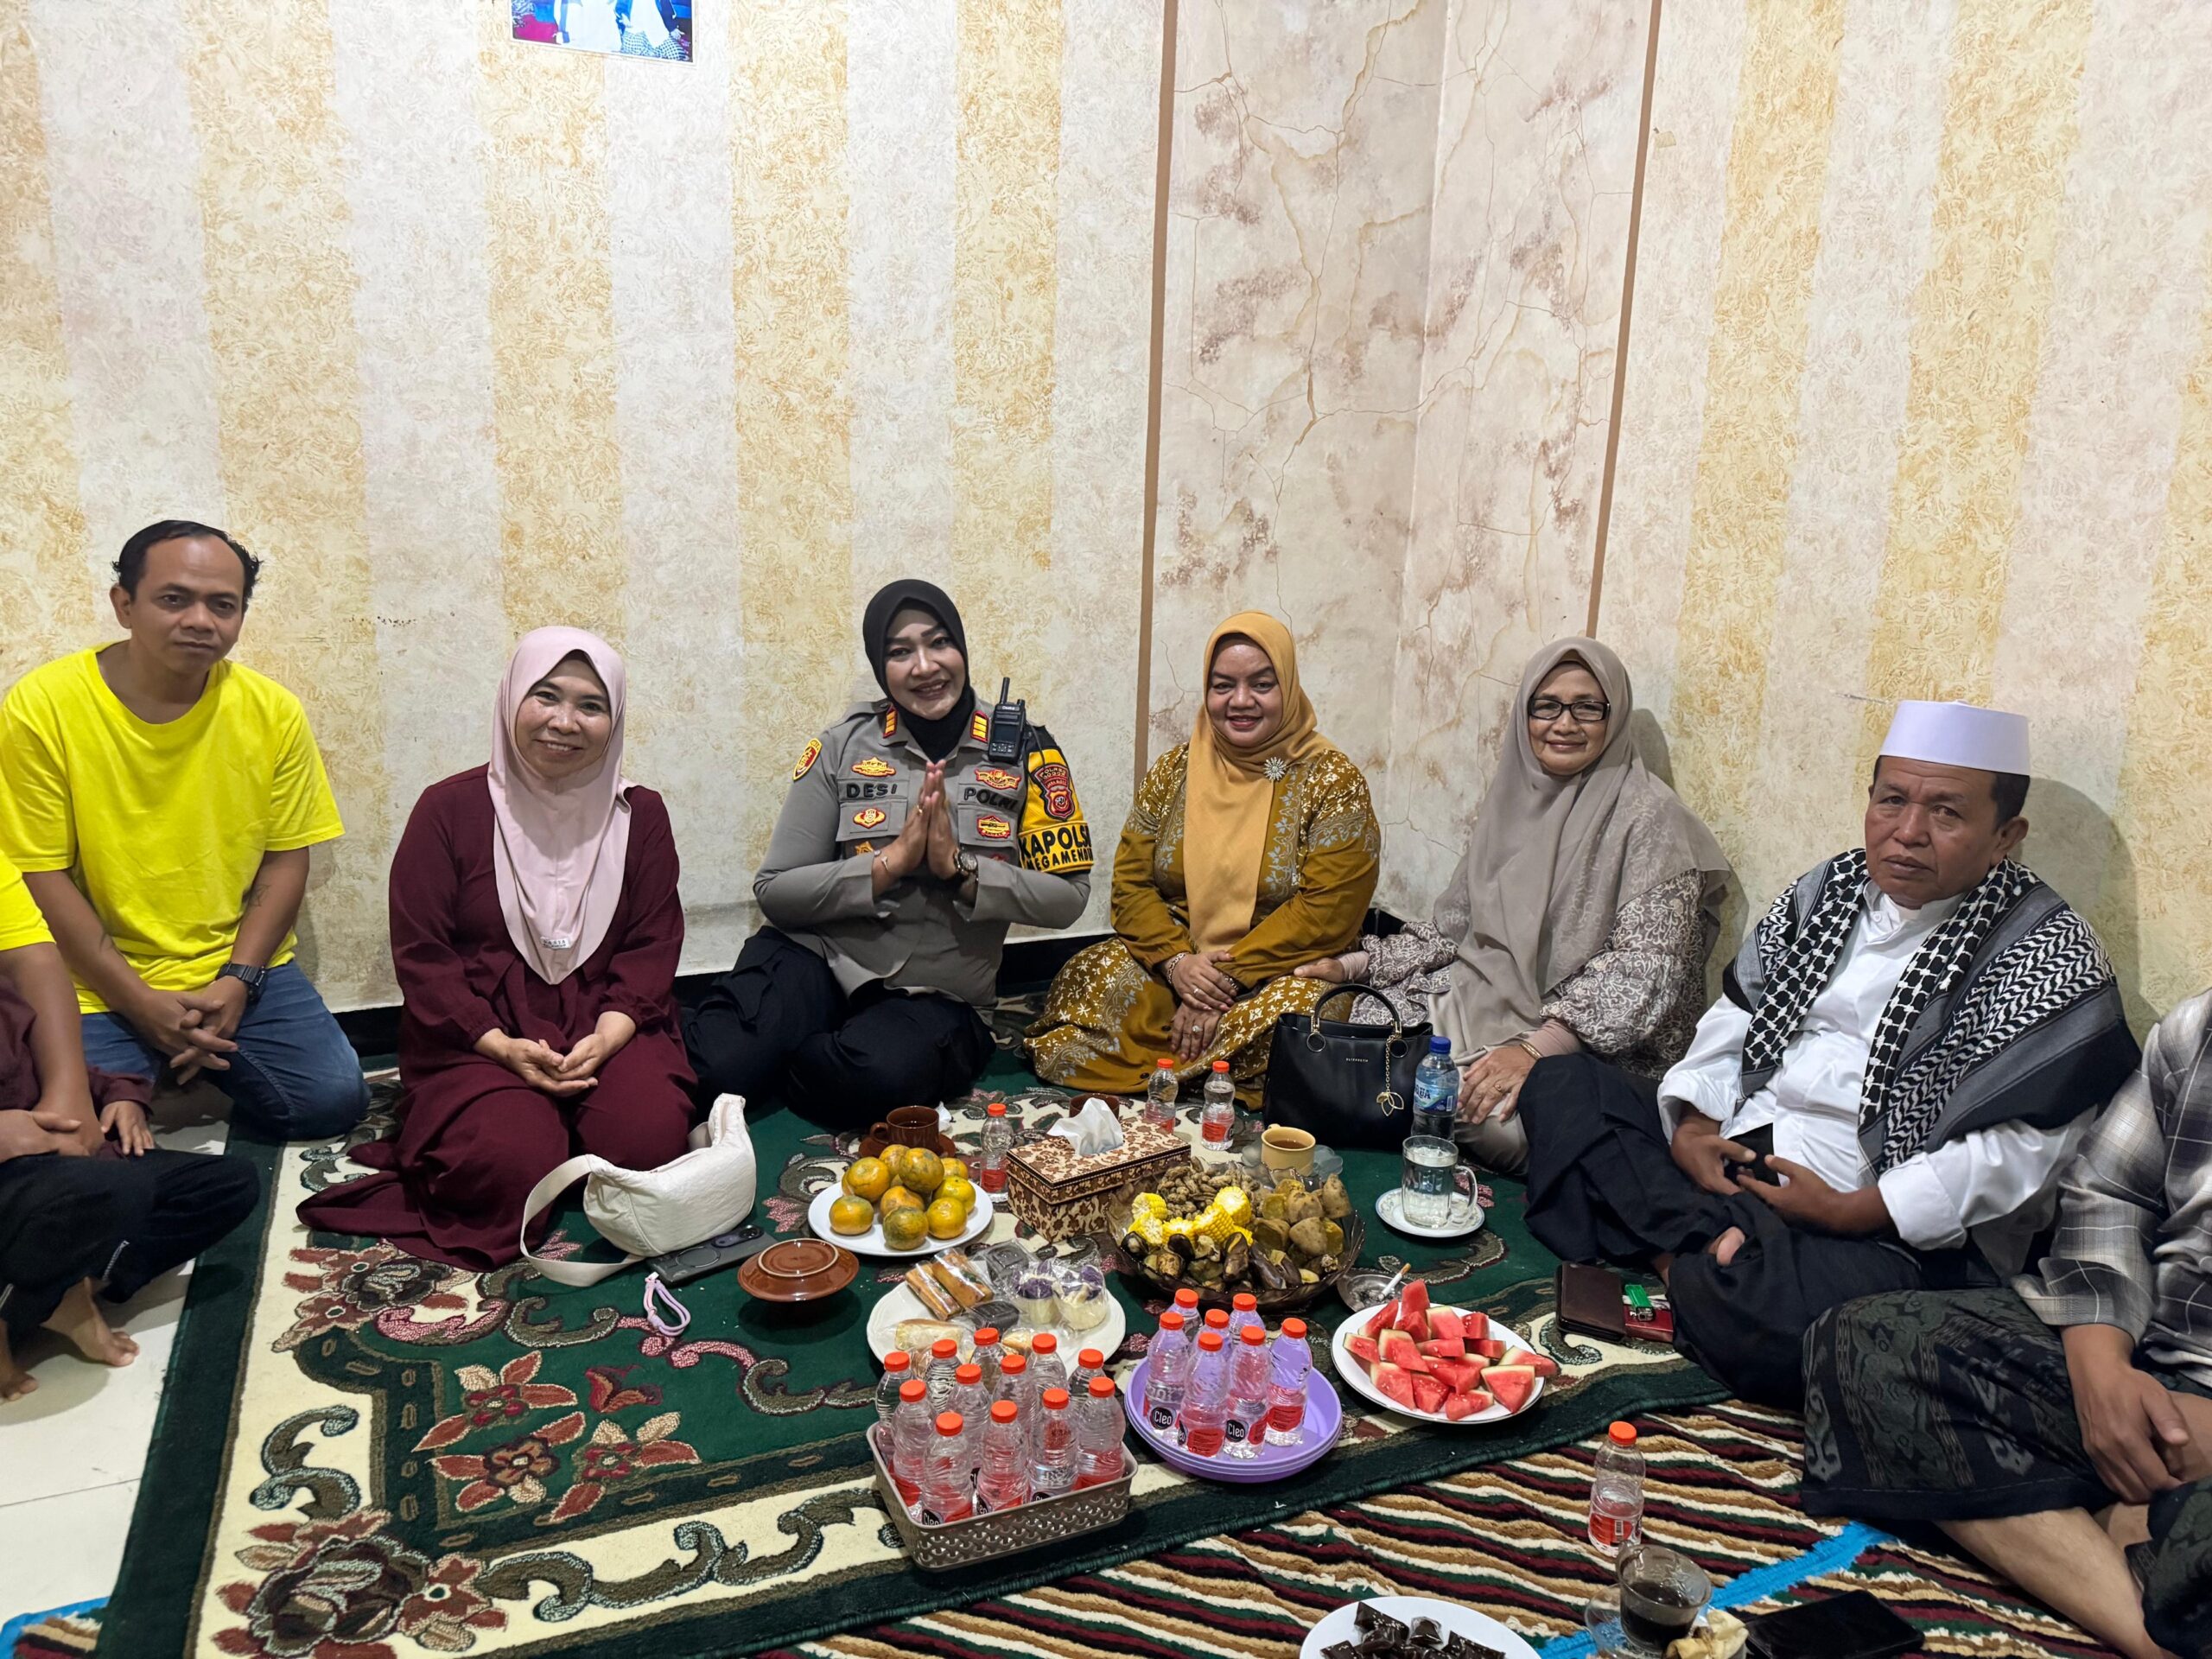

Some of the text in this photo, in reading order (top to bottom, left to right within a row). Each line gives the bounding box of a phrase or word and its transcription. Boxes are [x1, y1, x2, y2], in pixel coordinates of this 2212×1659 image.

[847, 783, 898, 798] DESI
[964, 787, 1018, 810] POLRI
[1154, 1410, 1172, 1425] Cleo
[1228, 1423, 1244, 1438] Cleo
